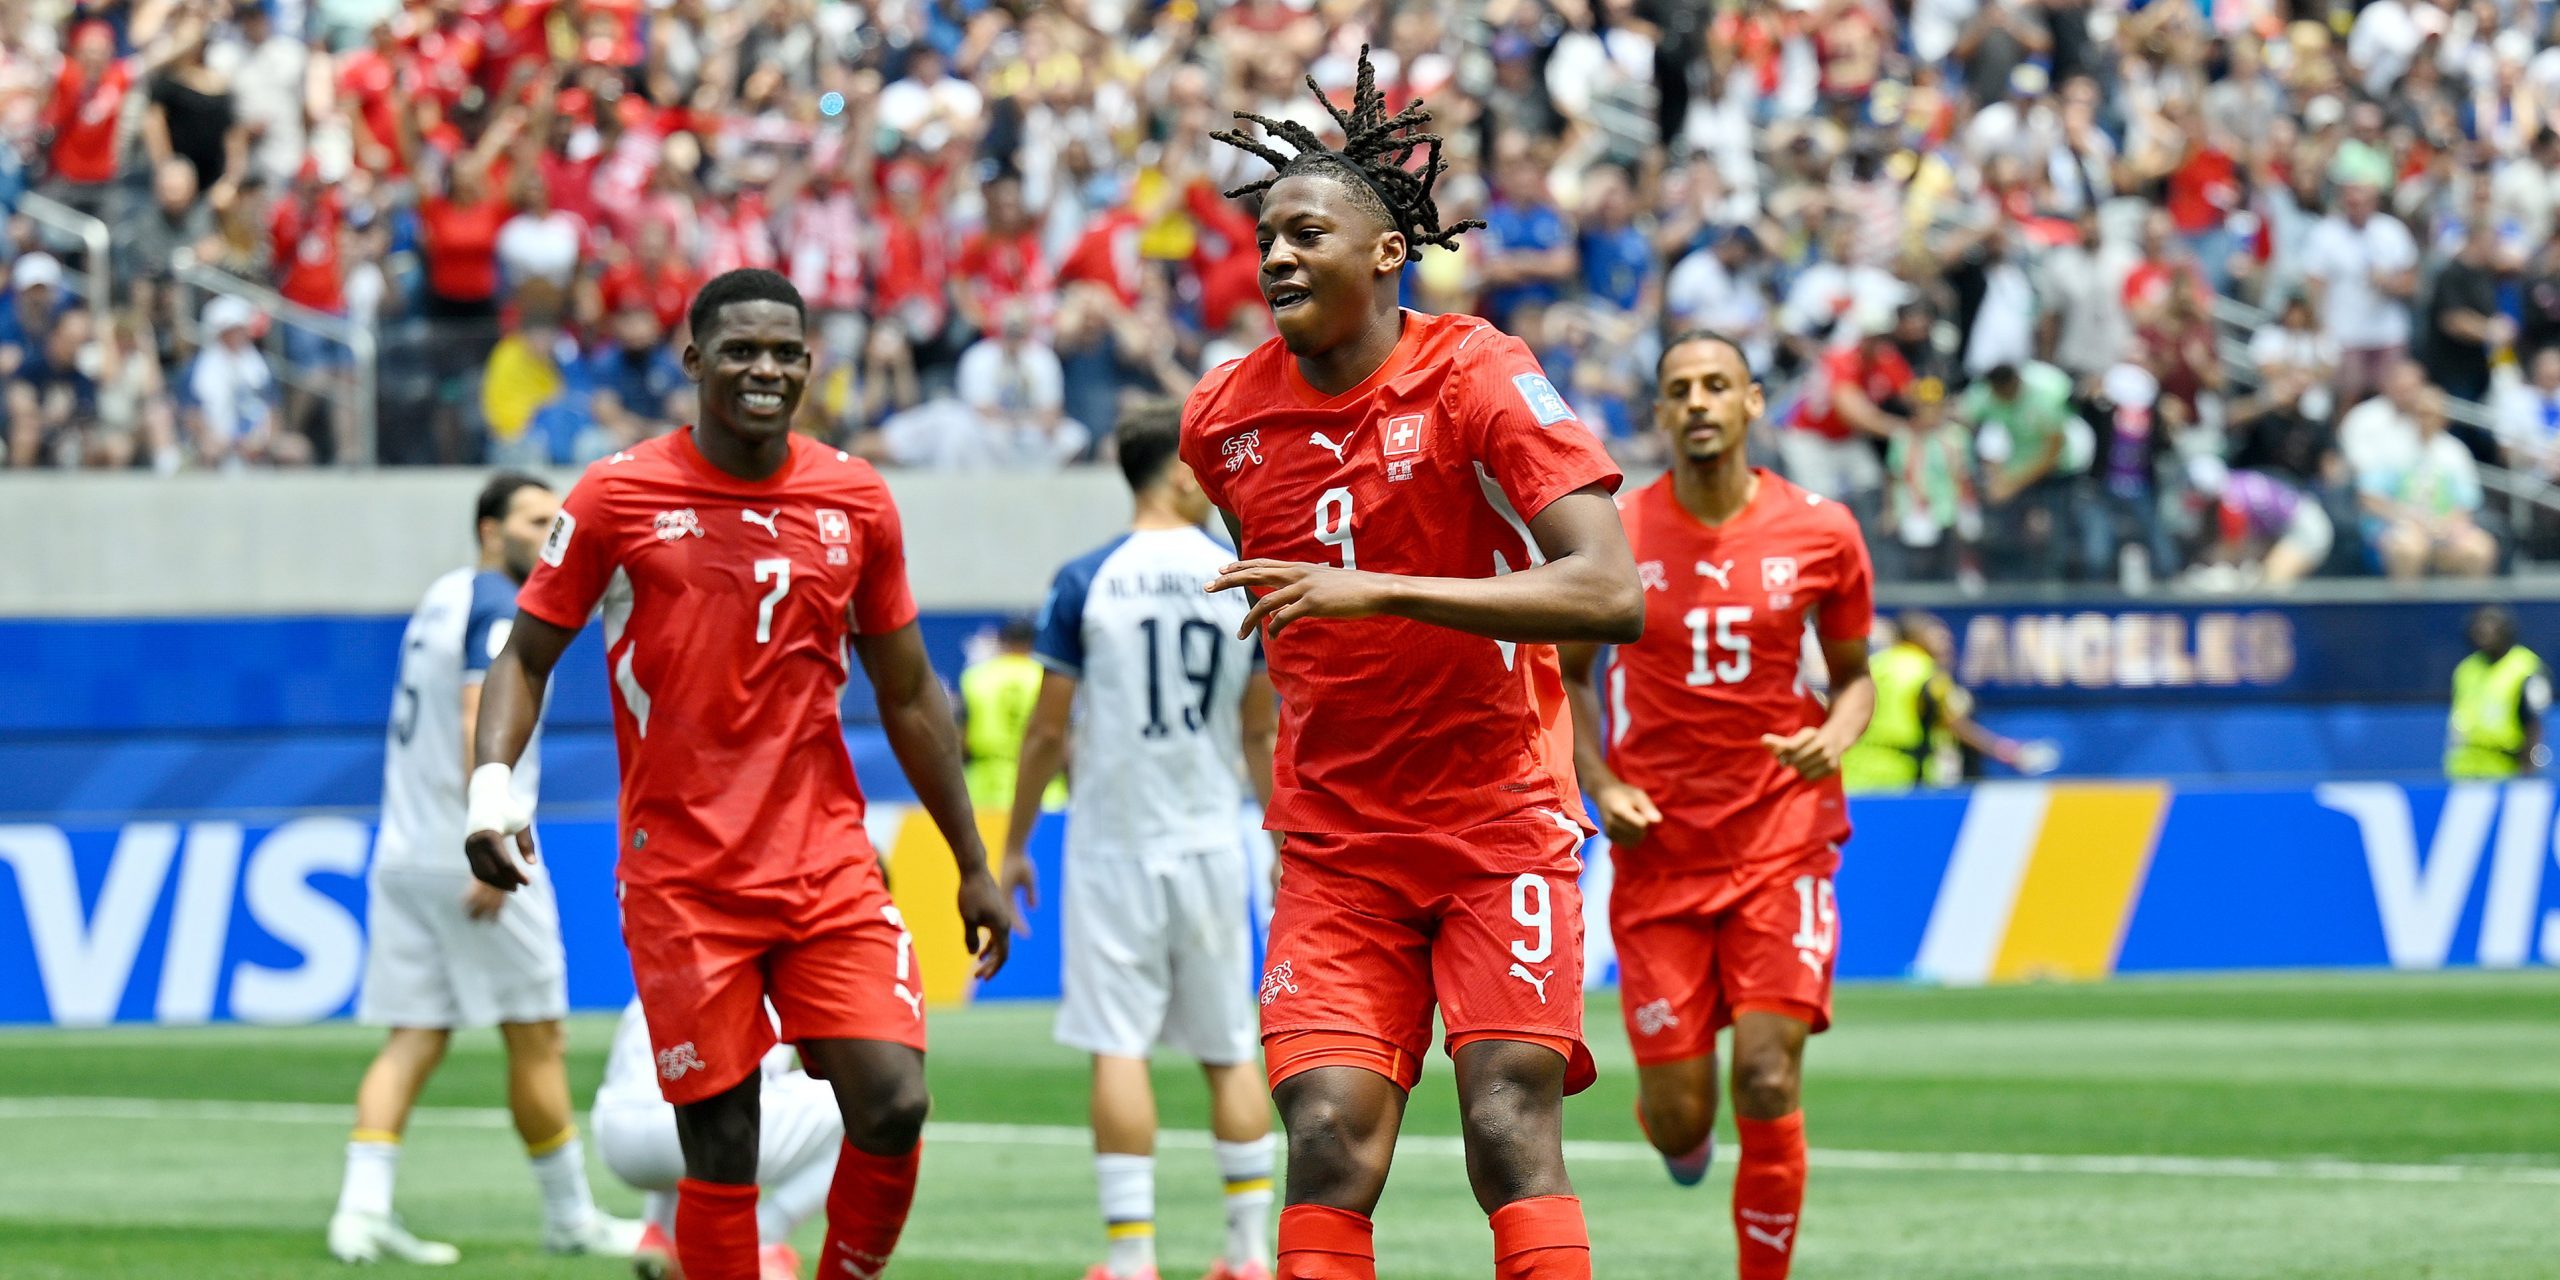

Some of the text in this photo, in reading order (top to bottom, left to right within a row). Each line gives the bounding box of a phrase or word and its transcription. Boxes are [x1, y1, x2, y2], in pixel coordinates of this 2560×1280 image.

[1314, 486, 1357, 570] 9
[754, 558, 791, 644] 7
[1140, 617, 1226, 739] 19
[1683, 606, 1754, 686] 15
[1792, 875, 1836, 956] 15
[2312, 779, 2560, 969] VI
[880, 905, 913, 981] 7
[1510, 872, 1552, 964] 9
